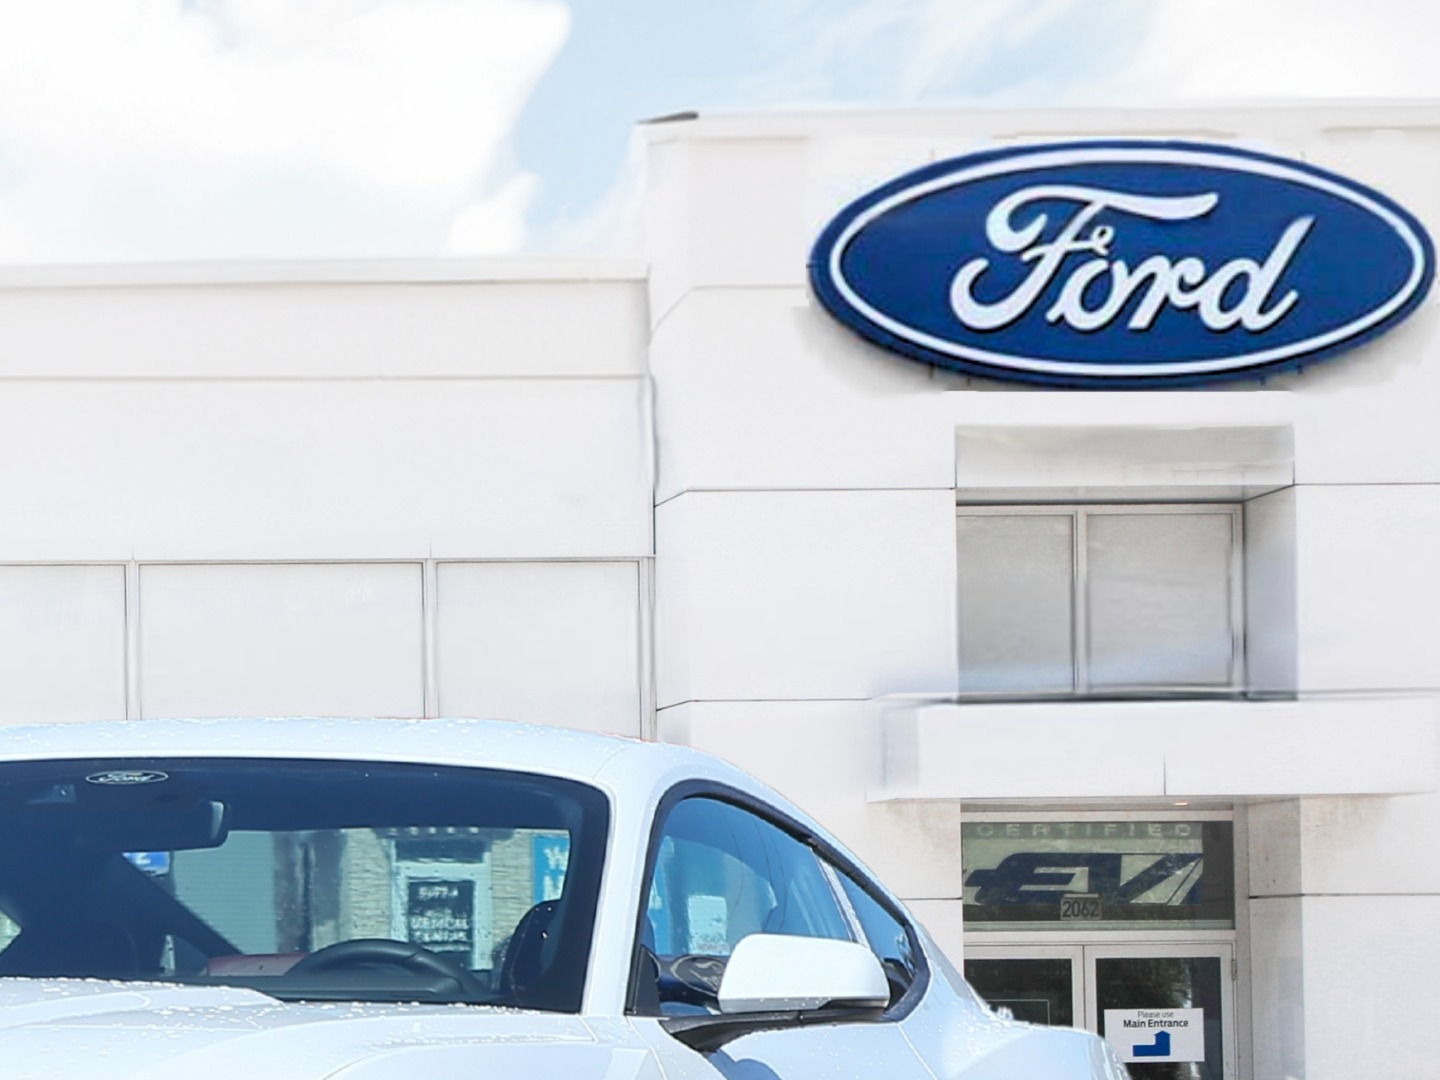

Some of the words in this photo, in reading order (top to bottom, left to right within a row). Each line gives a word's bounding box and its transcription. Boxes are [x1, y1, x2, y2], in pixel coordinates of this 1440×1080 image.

[949, 184, 1316, 331] Ford
[976, 823, 1192, 838] CERTIFIED
[1061, 900, 1100, 918] 2062
[1137, 1010, 1160, 1018] Please
[1123, 1019, 1146, 1028] Main
[1148, 1019, 1189, 1028] Entrance
